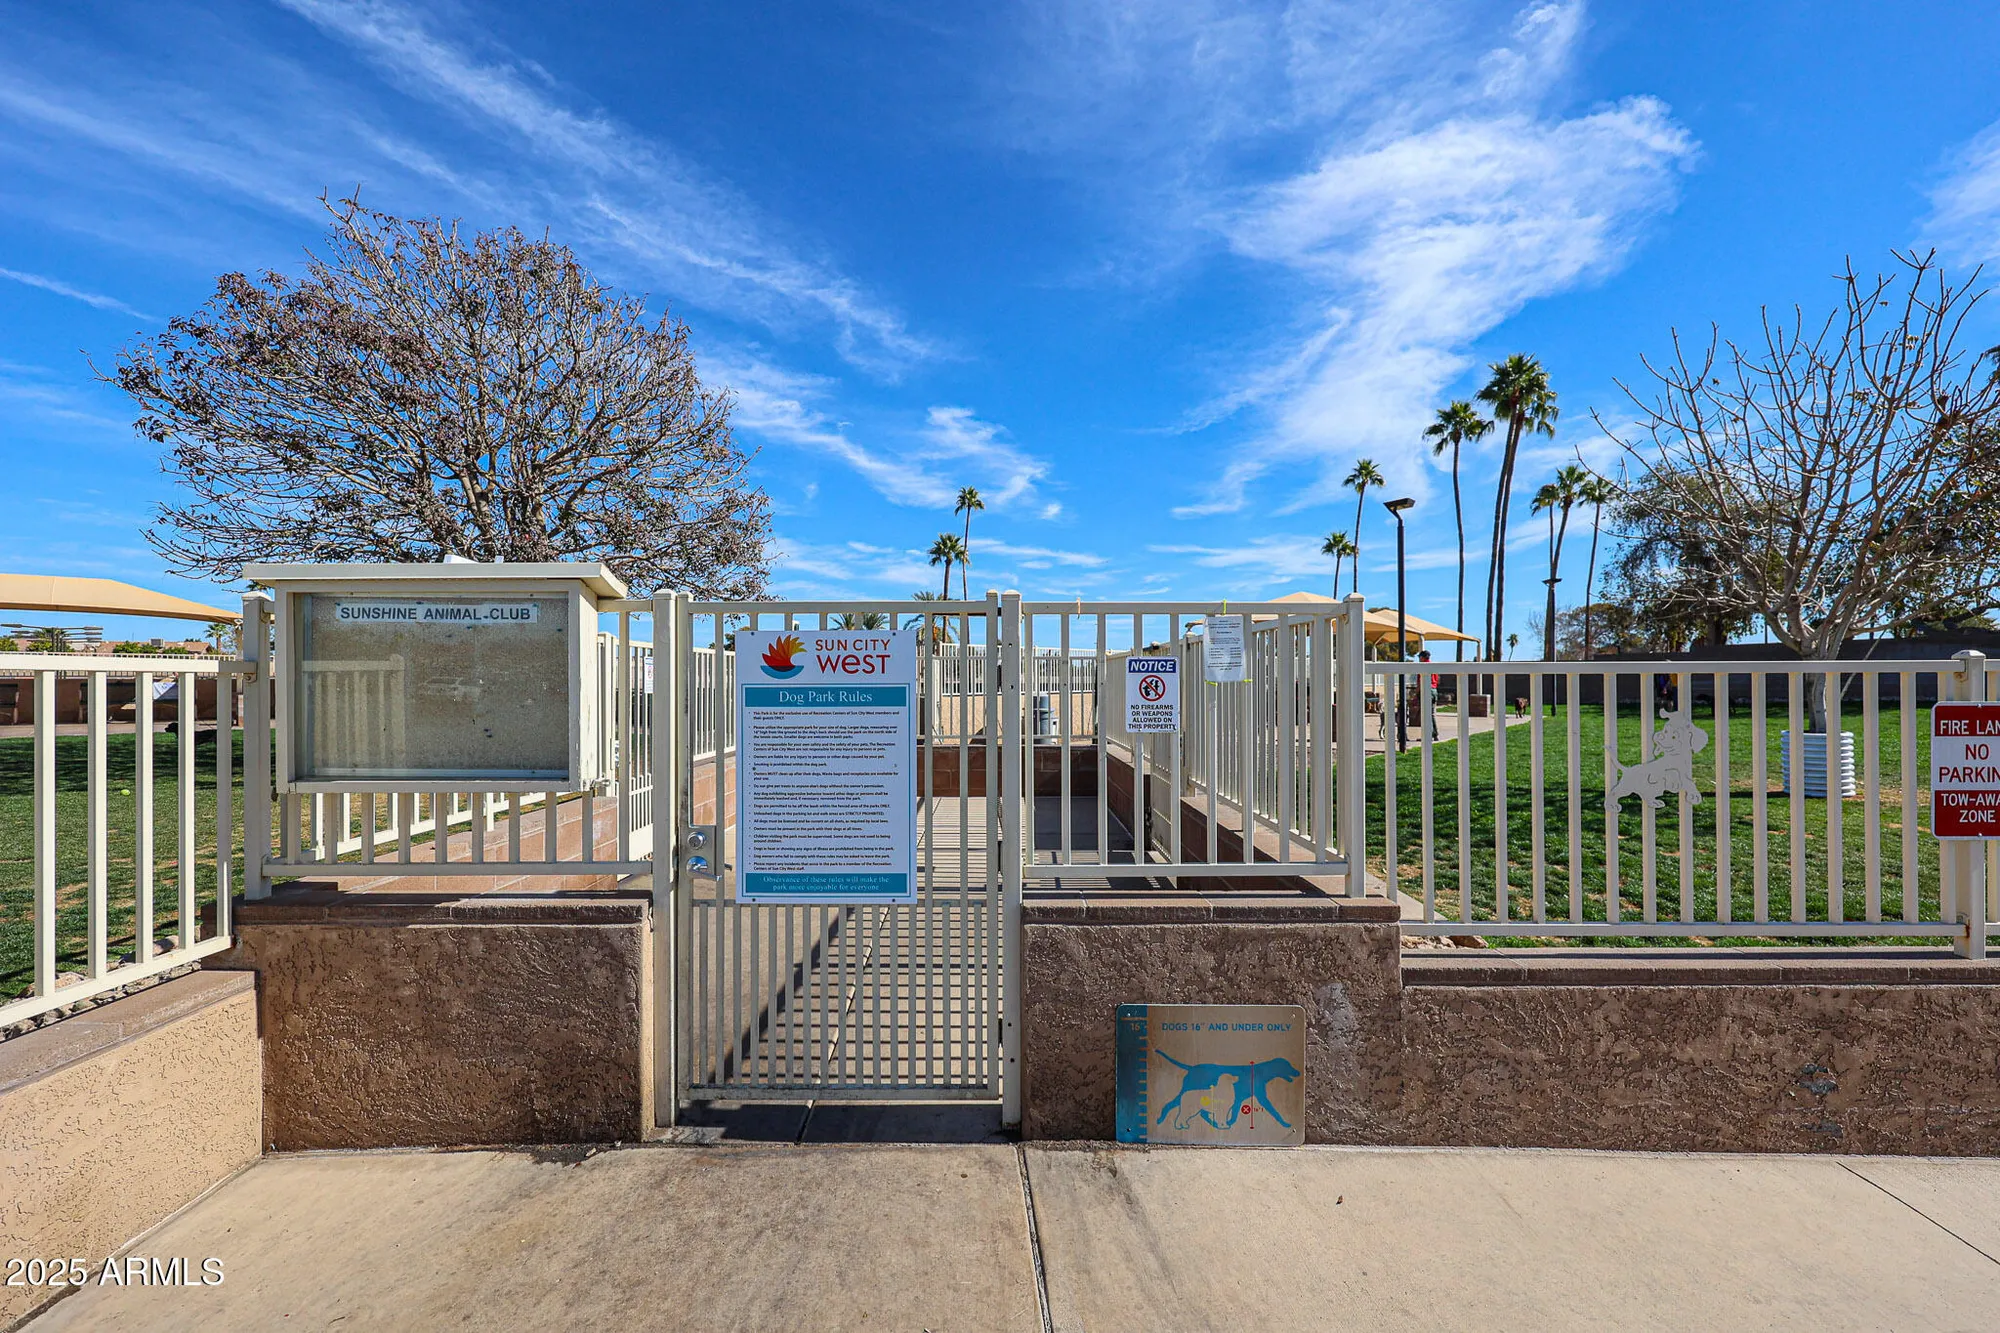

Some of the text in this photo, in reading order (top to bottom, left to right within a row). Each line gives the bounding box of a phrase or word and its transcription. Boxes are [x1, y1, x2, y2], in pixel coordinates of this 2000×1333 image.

[340, 607, 531, 620] SUNSHINE ANIMAL CLUB
[815, 639, 891, 651] SUN CITY
[1130, 661, 1174, 672] NOTICE
[779, 691, 873, 705] Dog Park Rules
[1940, 720, 2000, 735] FIRE LAN
[1965, 744, 1990, 760] NO
[1939, 767, 2000, 783] PARKIN
[1959, 810, 1996, 823] ZONE
[773, 884, 787, 892] park
[807, 884, 837, 892] enjoyable
[1162, 1023, 1188, 1031] DOGS
[1209, 1023, 1228, 1031] AND
[1232, 1023, 1263, 1031] UNDER
[1267, 1023, 1292, 1031] ONLY
